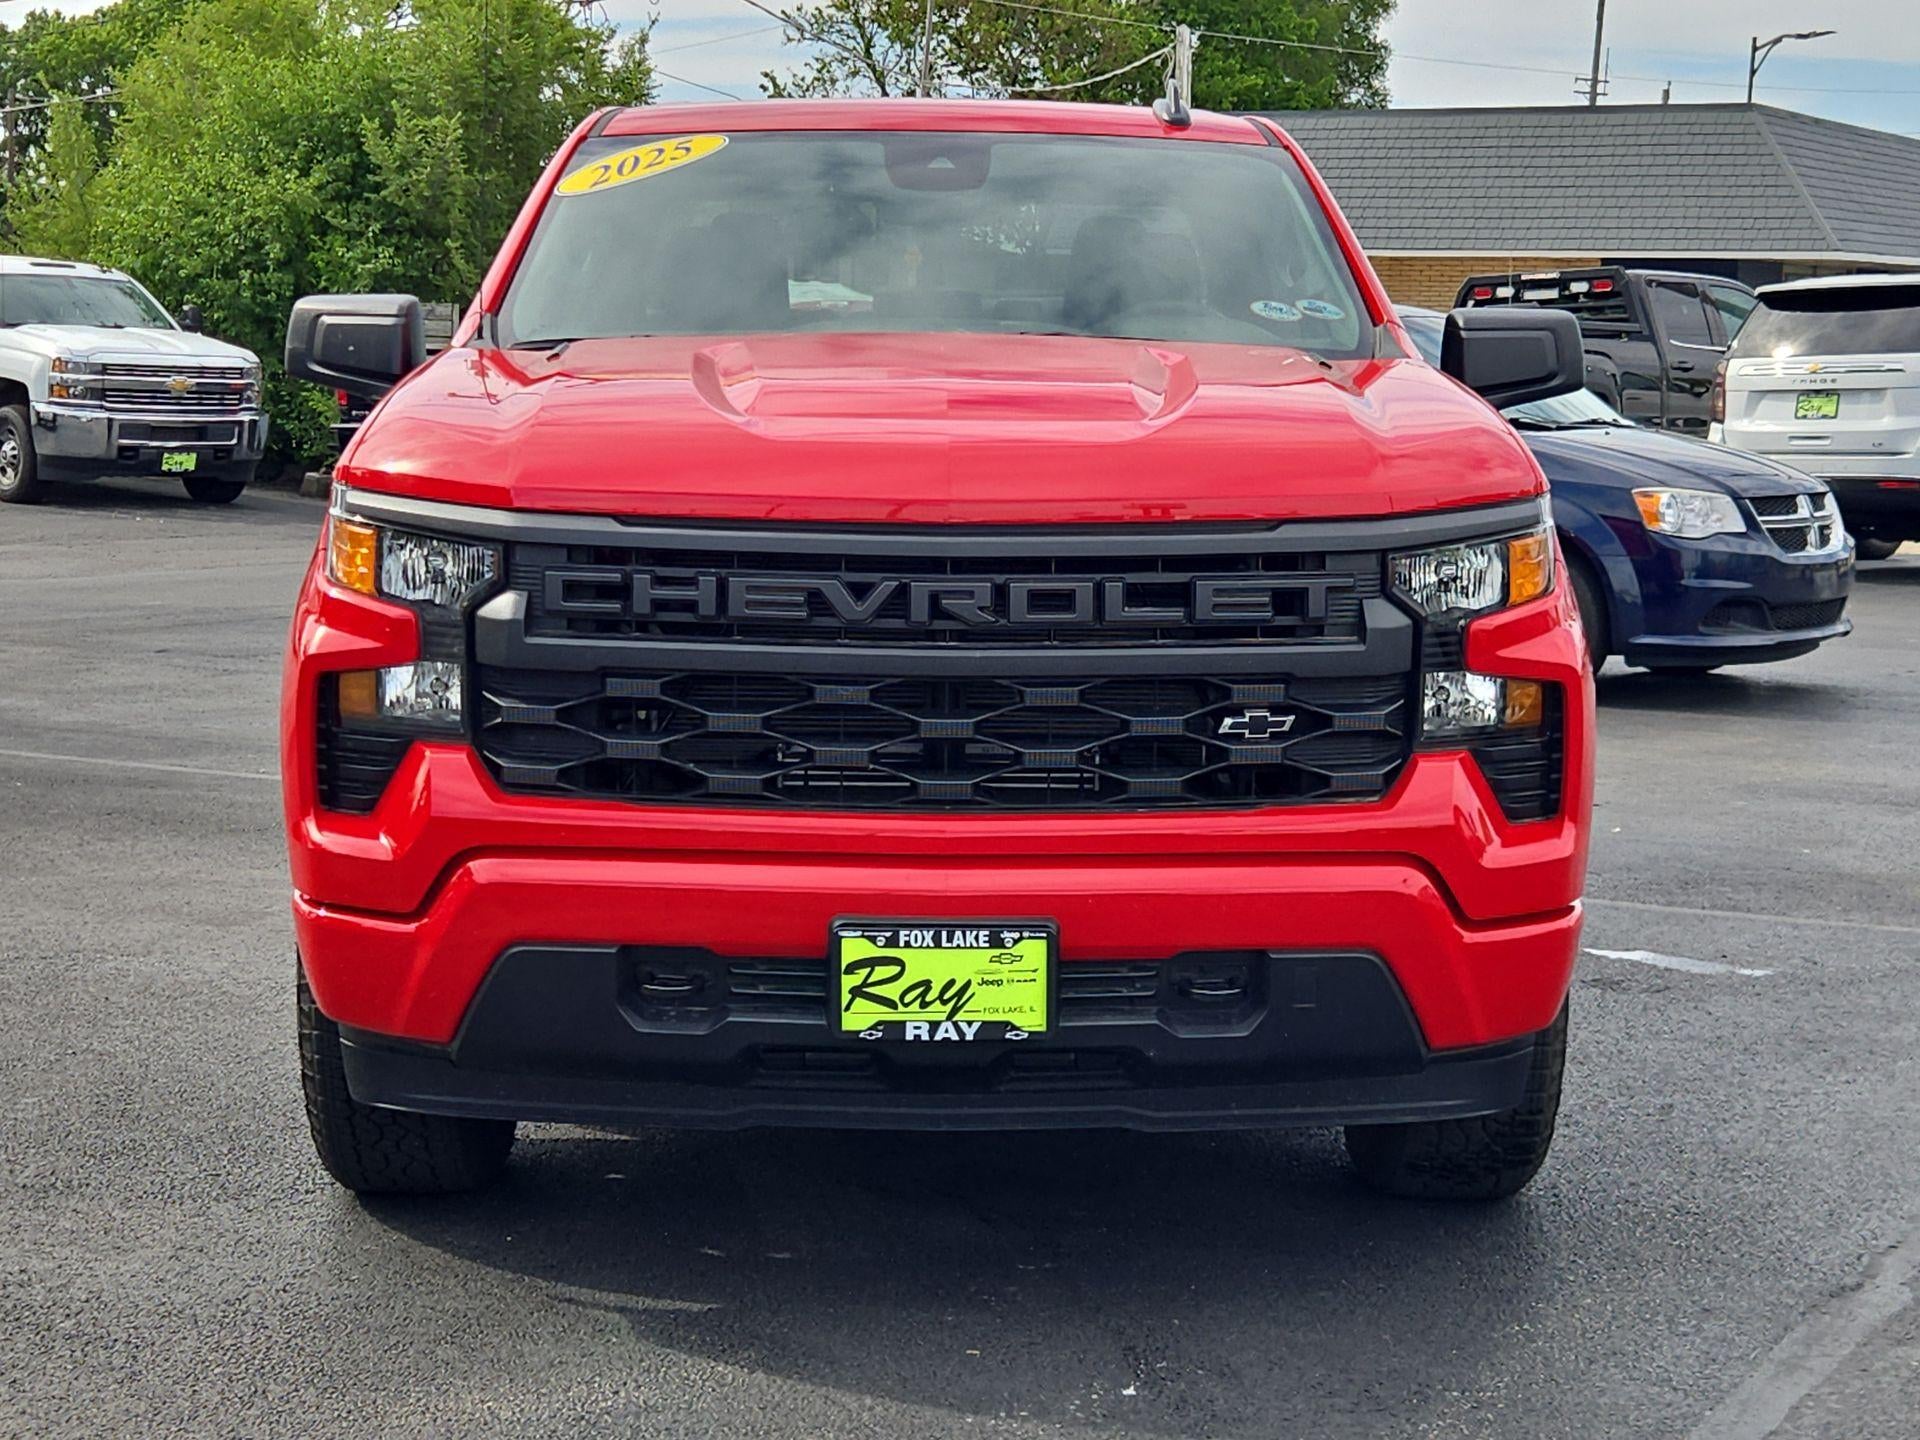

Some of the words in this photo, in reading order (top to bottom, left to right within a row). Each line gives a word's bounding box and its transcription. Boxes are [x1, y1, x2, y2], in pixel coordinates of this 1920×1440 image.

[588, 138, 693, 189] 2025
[544, 570, 1355, 625] CHEVROLET
[899, 930, 935, 948] FOX
[941, 931, 990, 948] LAKE
[843, 955, 976, 1021] Ray
[977, 977, 1004, 987] Jeep
[905, 1020, 983, 1041] RAY
